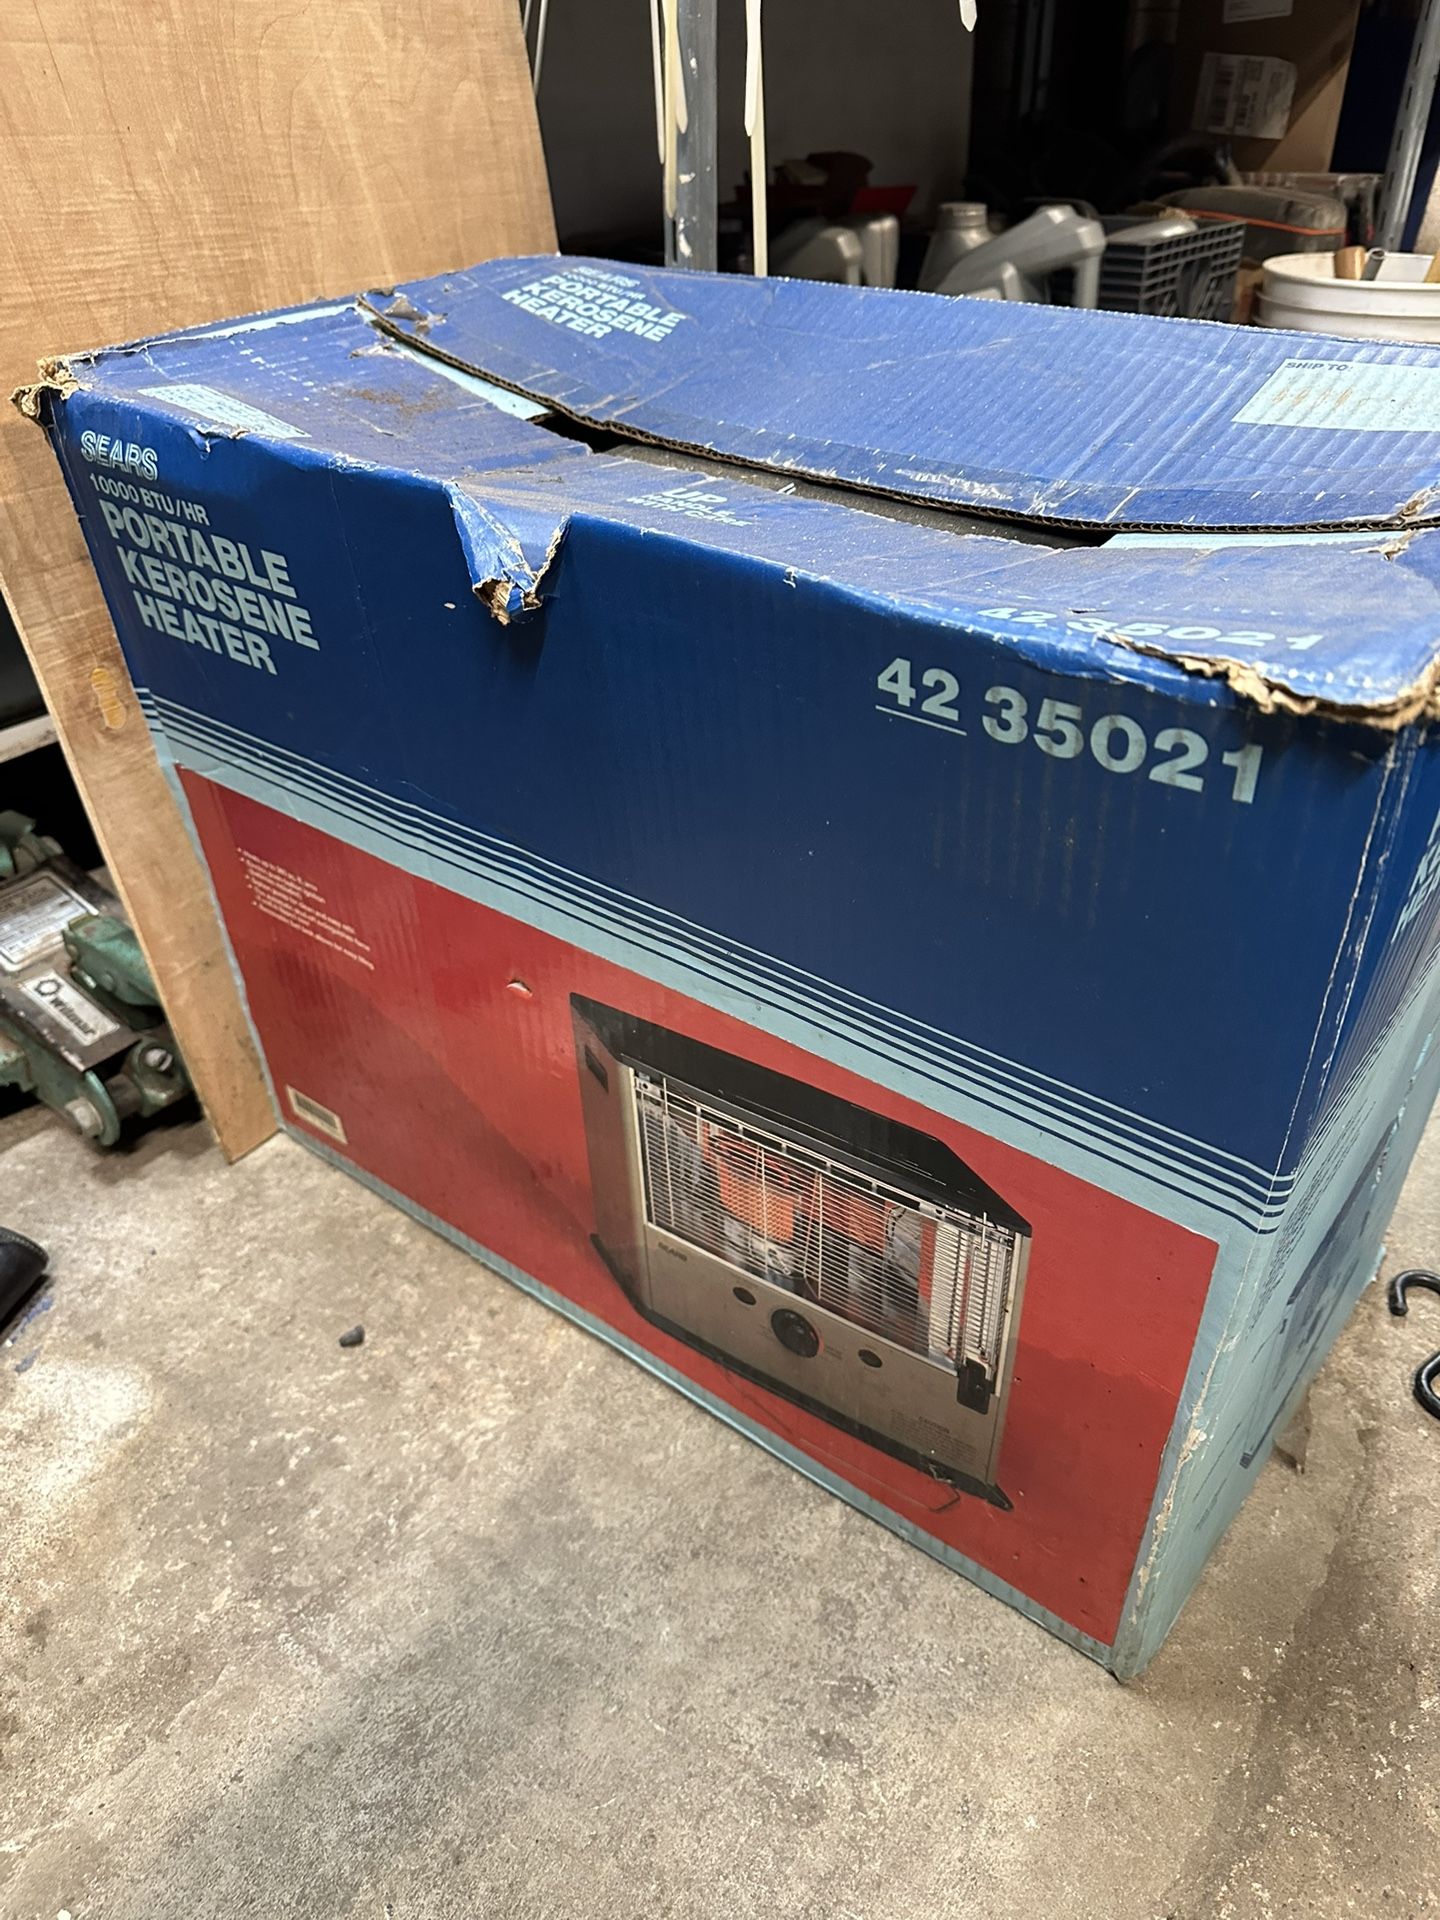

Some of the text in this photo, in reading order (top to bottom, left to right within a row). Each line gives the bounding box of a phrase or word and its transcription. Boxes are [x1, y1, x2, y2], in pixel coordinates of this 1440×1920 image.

[500, 289, 614, 339] HEATER
[521, 281, 674, 343] KEROSENE
[541, 274, 688, 328] PORTABLE
[1285, 361, 1325, 370] SHIP
[80, 429, 159, 481] SEARS
[90, 472, 211, 527] 10000 BTU/HR
[641, 494, 736, 517] HANDLE
[661, 487, 728, 503] UP
[99, 498, 298, 600] PORTABLE
[116, 544, 321, 651] KEROSENE
[132, 589, 279, 676] HEATER
[976, 606, 1325, 651] 42 35021
[877, 657, 1264, 805] 42 35021
